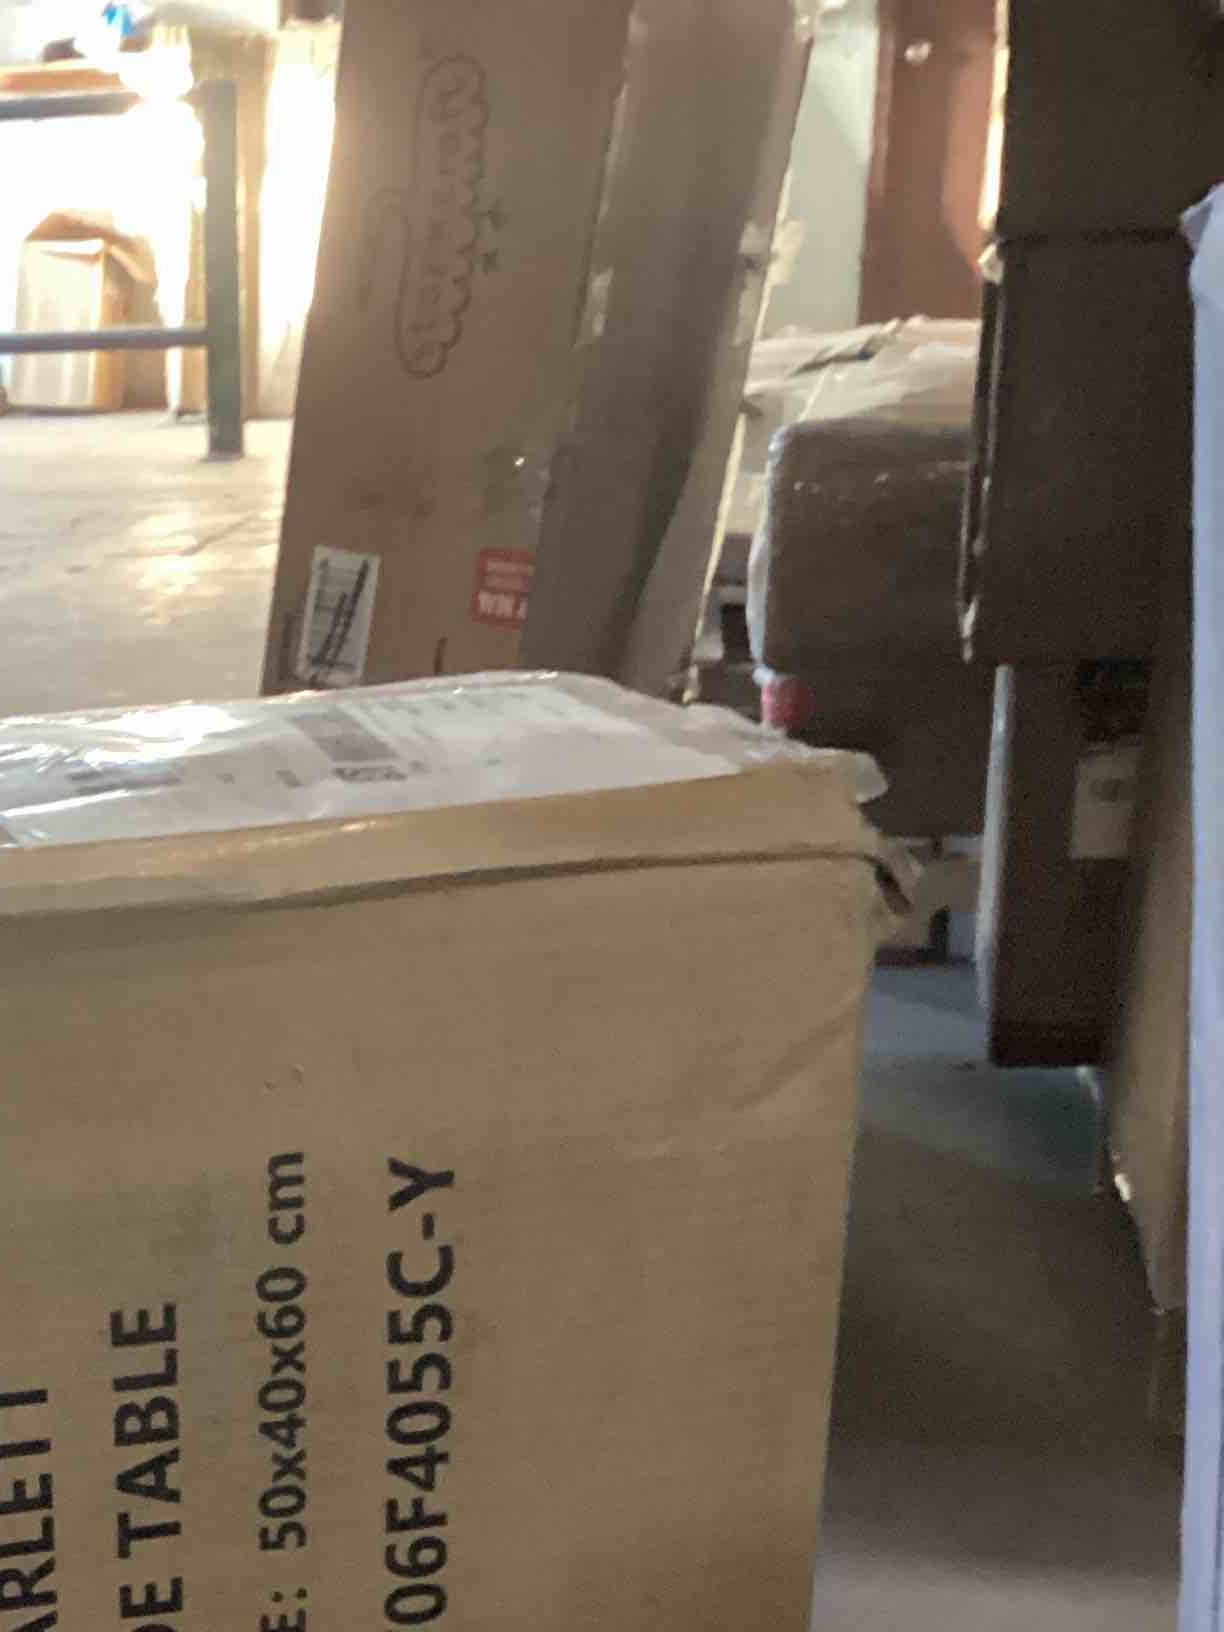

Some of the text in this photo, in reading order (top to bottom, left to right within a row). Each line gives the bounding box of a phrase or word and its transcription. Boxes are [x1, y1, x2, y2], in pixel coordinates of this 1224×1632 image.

[267, 1151, 305, 1245] cm
[110, 1303, 182, 1560] TABLE
[255, 1266, 307, 1551] 50x40x60
